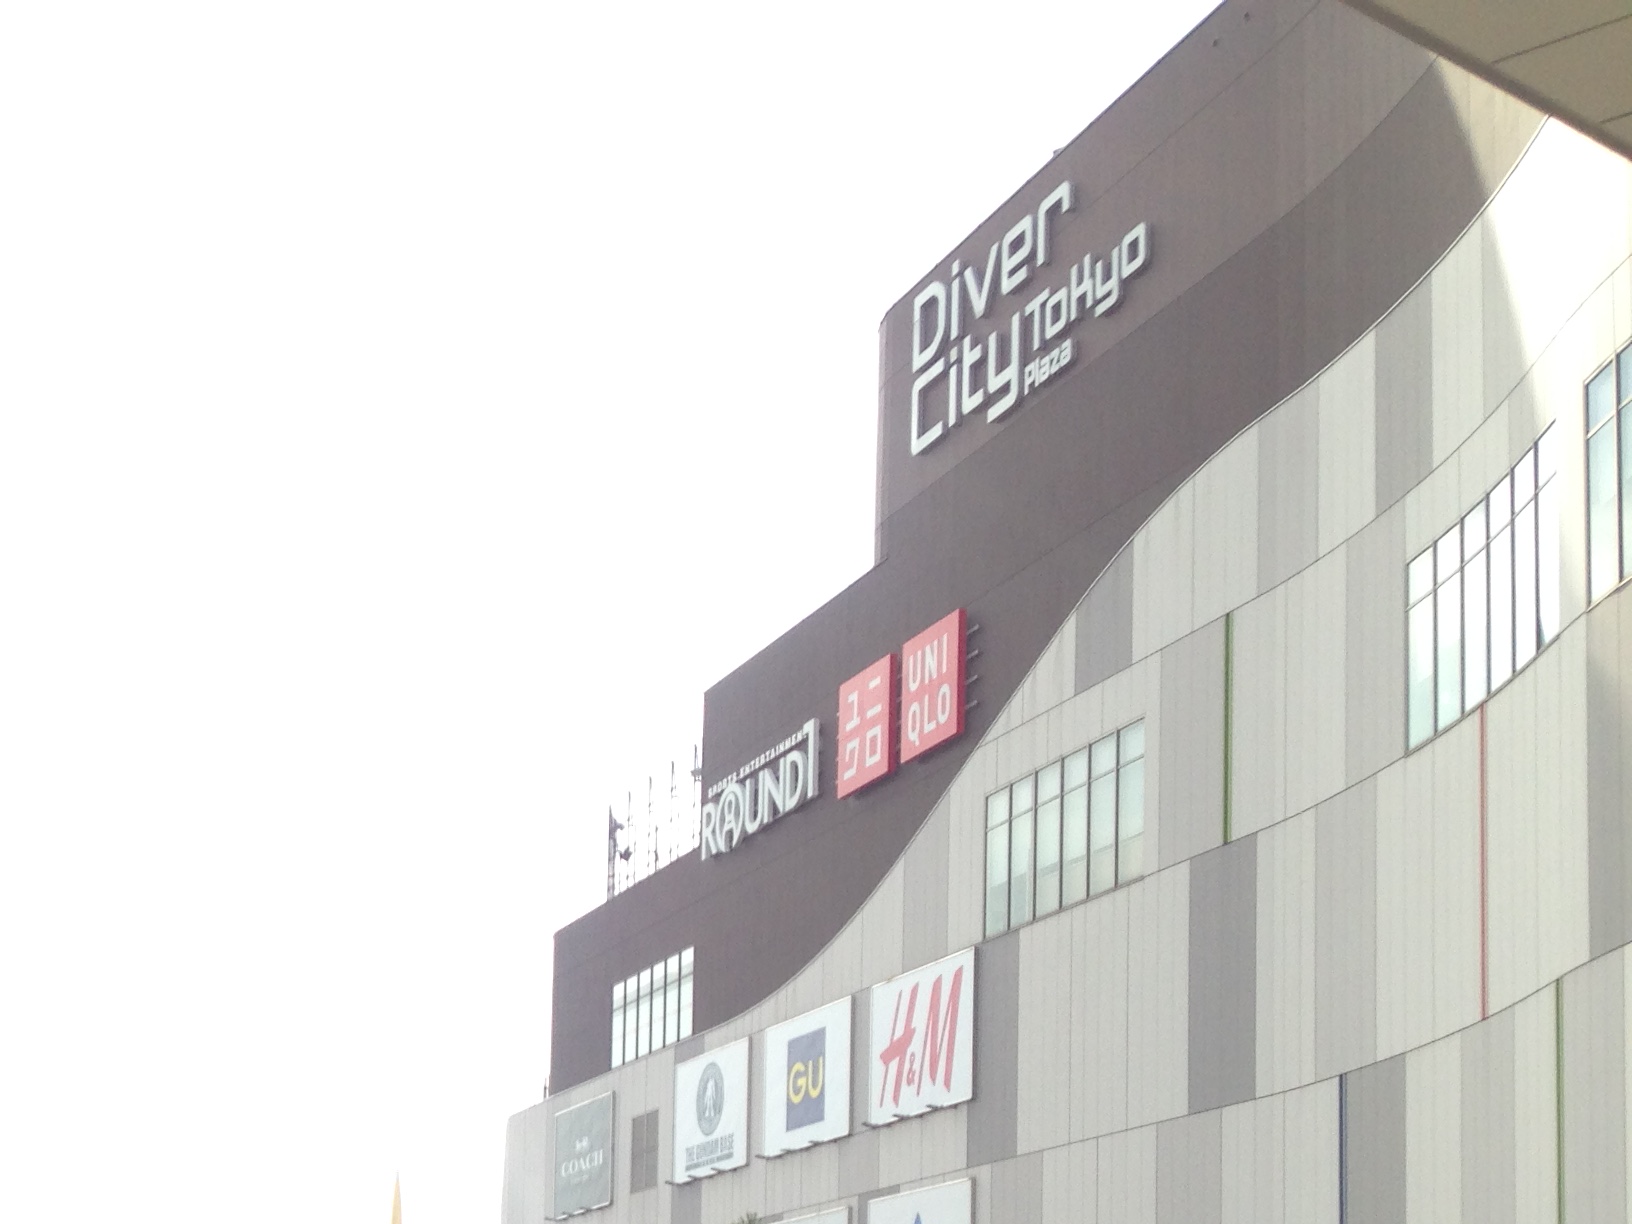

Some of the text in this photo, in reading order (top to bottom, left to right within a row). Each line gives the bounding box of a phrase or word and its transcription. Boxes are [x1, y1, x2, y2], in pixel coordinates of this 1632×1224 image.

[911, 179, 1072, 374] Diver
[910, 311, 1021, 457] City
[1024, 338, 1072, 396] Plaza
[908, 632, 948, 693] UNI
[907, 683, 951, 747] QLO
[879, 964, 964, 1109] H&M
[788, 1056, 824, 1105] GU
[561, 1149, 604, 1178] COACH
